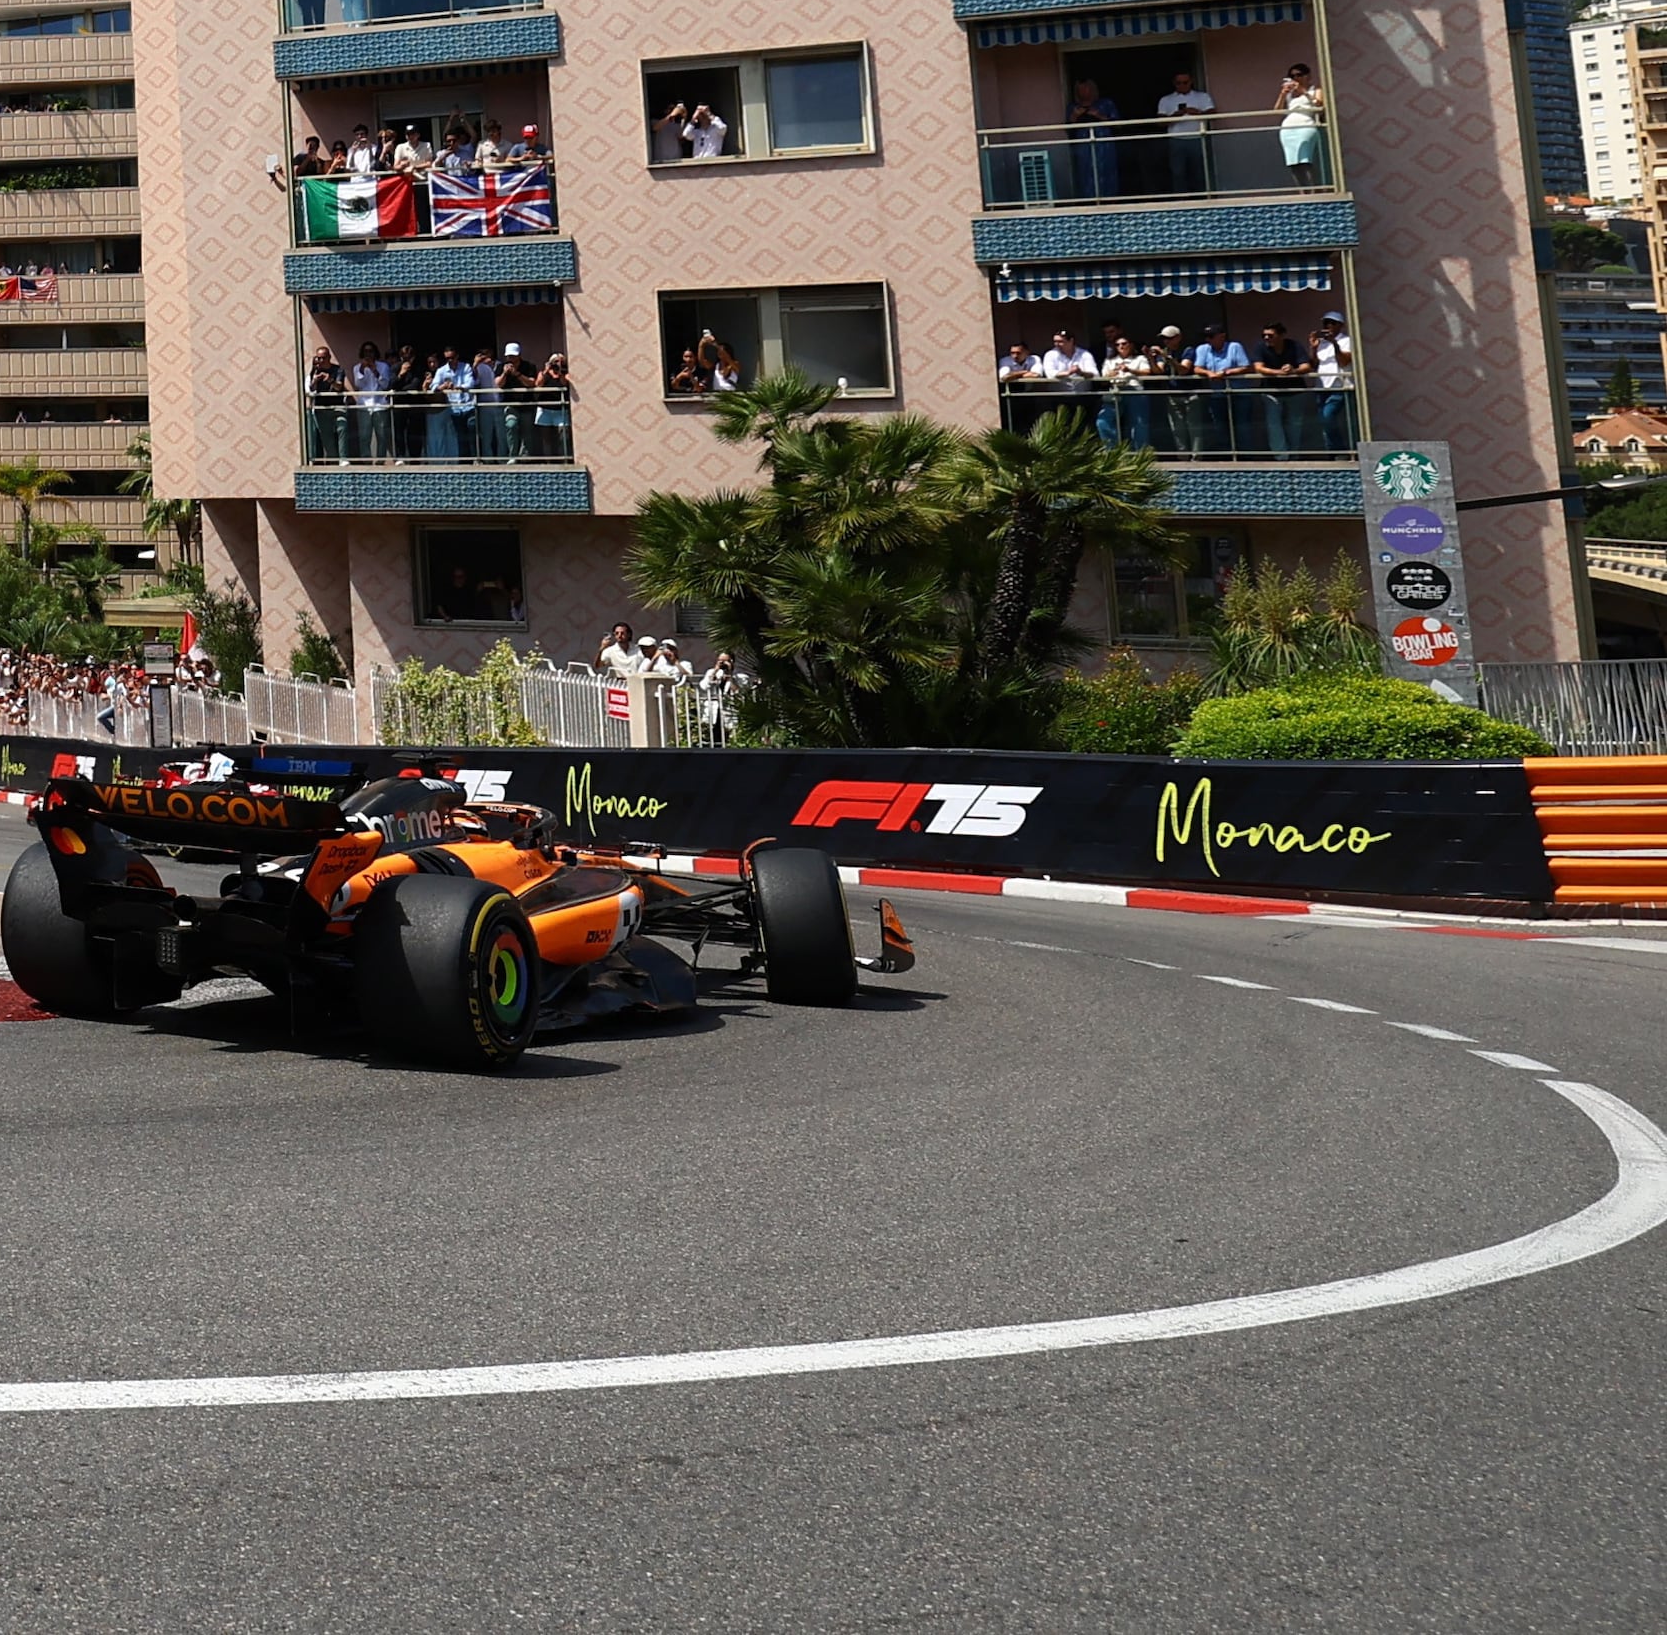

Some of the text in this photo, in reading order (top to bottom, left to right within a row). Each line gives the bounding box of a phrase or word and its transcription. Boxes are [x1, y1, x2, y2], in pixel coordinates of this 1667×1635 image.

[1382, 526, 1443, 534] MUNCHKINS
[1391, 583, 1447, 594] ARCADE
[1397, 590, 1444, 600] GAMES
[1392, 632, 1459, 652] BOWLING
[1404, 649, 1435, 662] &BAR
[288, 758, 317, 774] IBM
[93, 784, 290, 828] VELO.COM
[485, 805, 517, 814] VELO.COM
[454, 761, 1393, 878] 75 Monaco F1 75 Monaco
[327, 844, 371, 860] Dropbox
[585, 929, 612, 943] OKX
[469, 997, 498, 1060] ZERO
